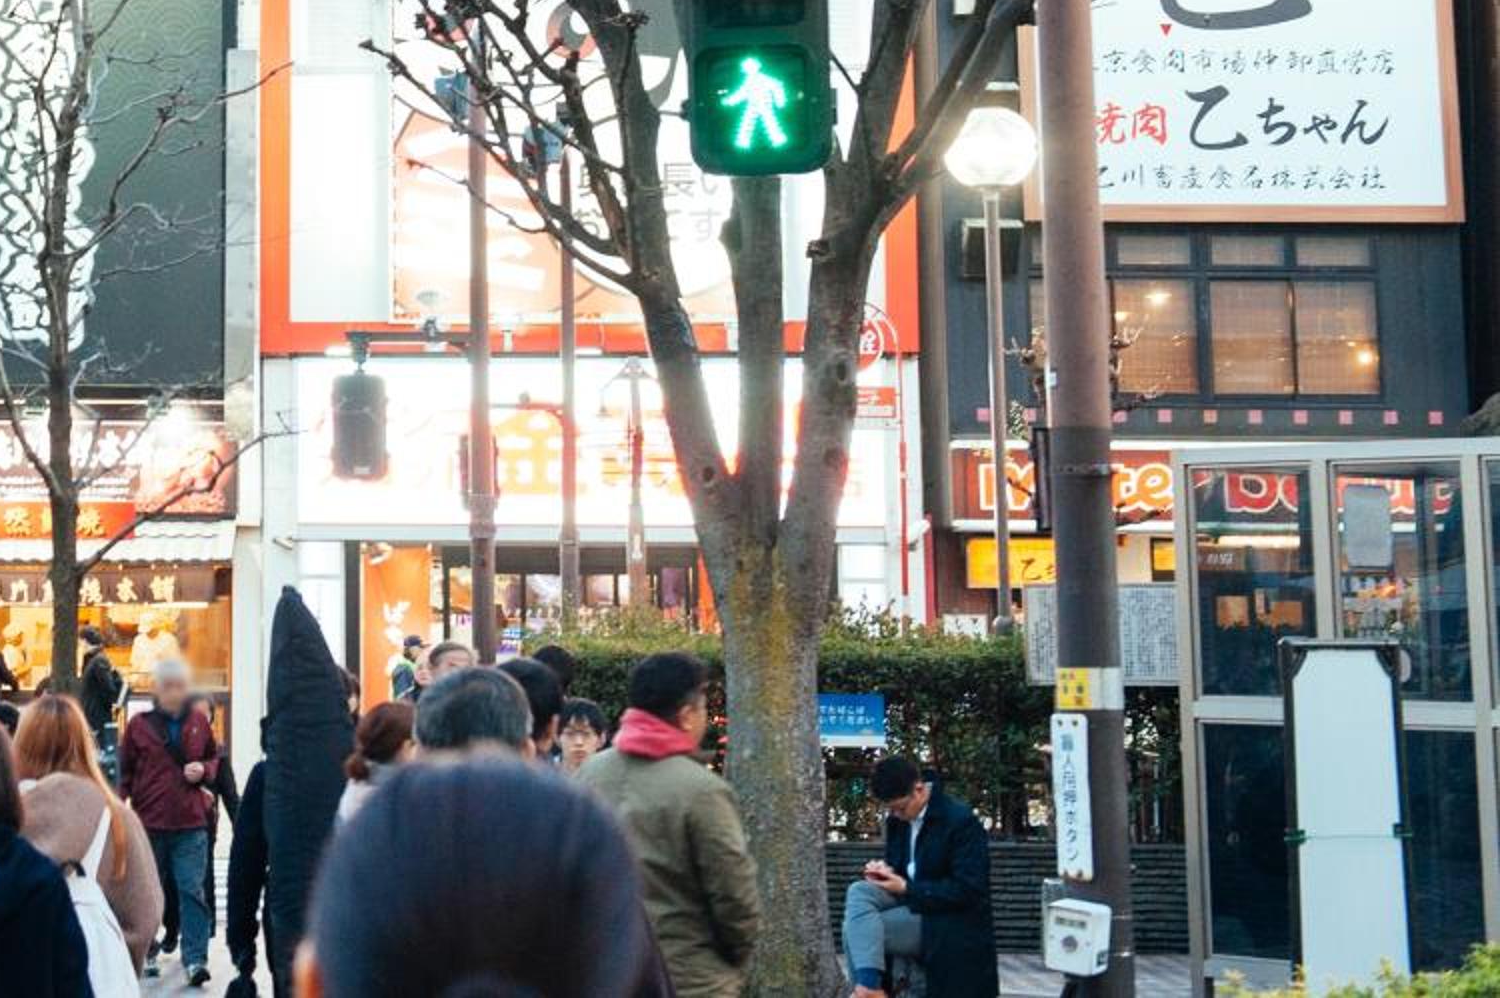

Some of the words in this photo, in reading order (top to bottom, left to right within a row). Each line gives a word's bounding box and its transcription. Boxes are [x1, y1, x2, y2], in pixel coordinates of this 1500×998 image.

[1092, 46, 1396, 76] 京食肉市場仲卸直営店
[1184, 84, 1390, 152] 乙ちゃん
